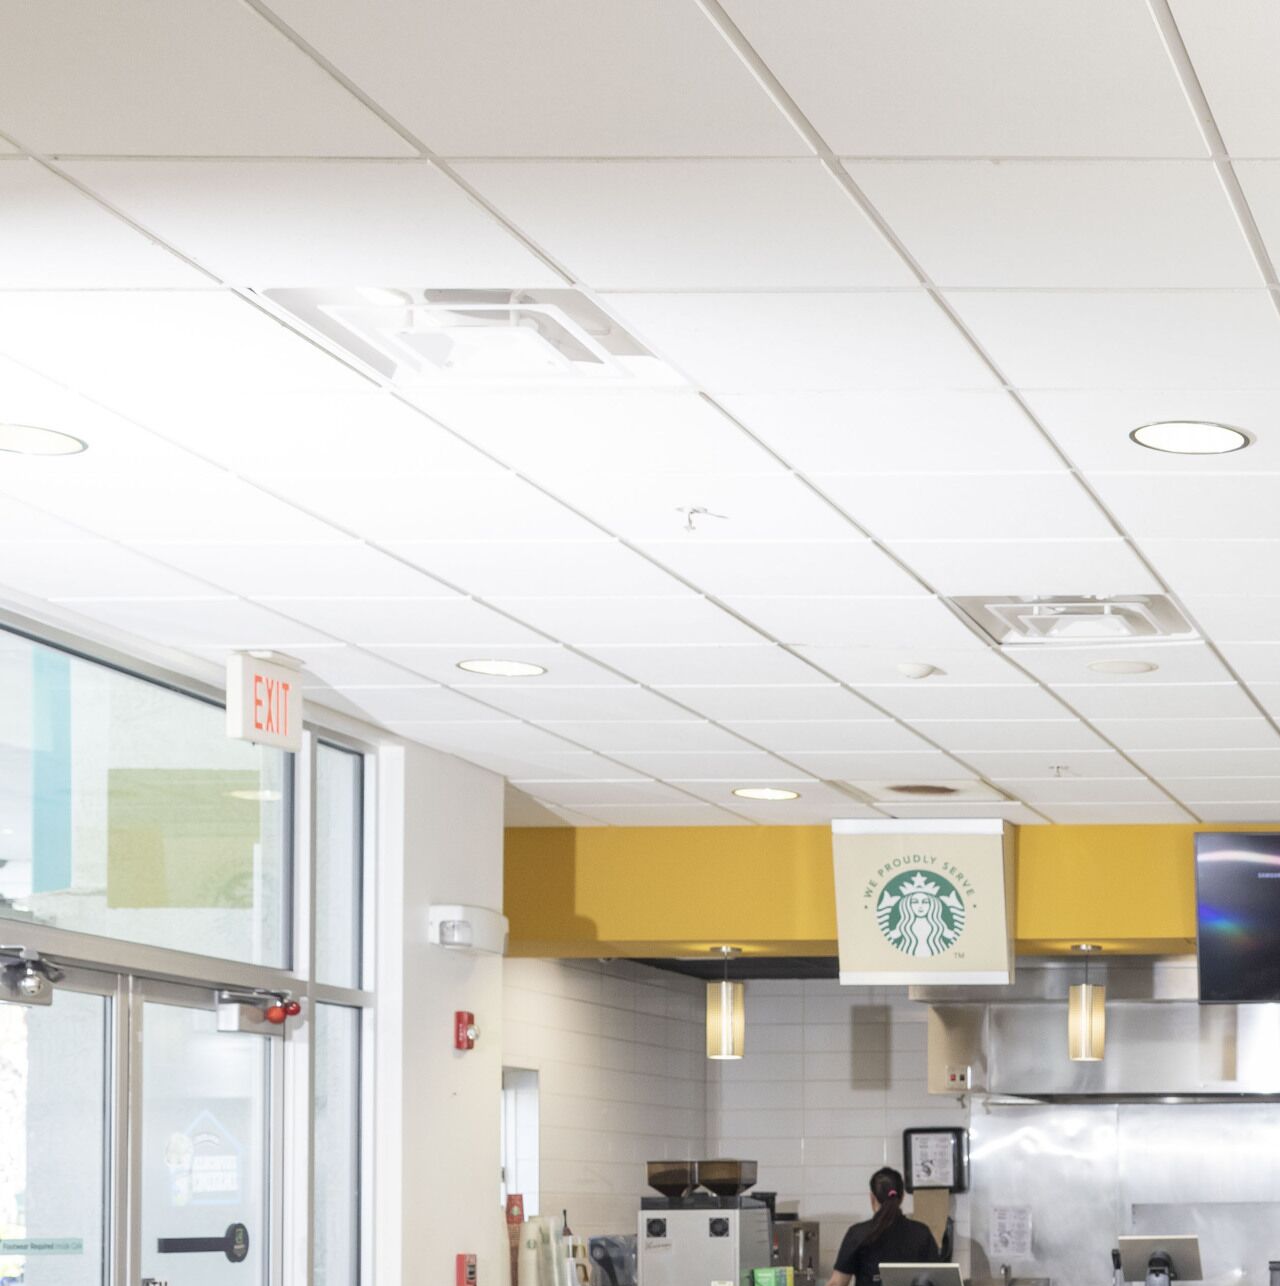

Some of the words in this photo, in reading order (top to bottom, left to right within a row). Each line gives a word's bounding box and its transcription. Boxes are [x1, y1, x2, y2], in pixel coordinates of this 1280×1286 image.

[254, 674, 289, 736] EXIT
[864, 879, 879, 899] WE
[878, 854, 937, 878] PROUDLY
[942, 861, 975, 897] SERVE
